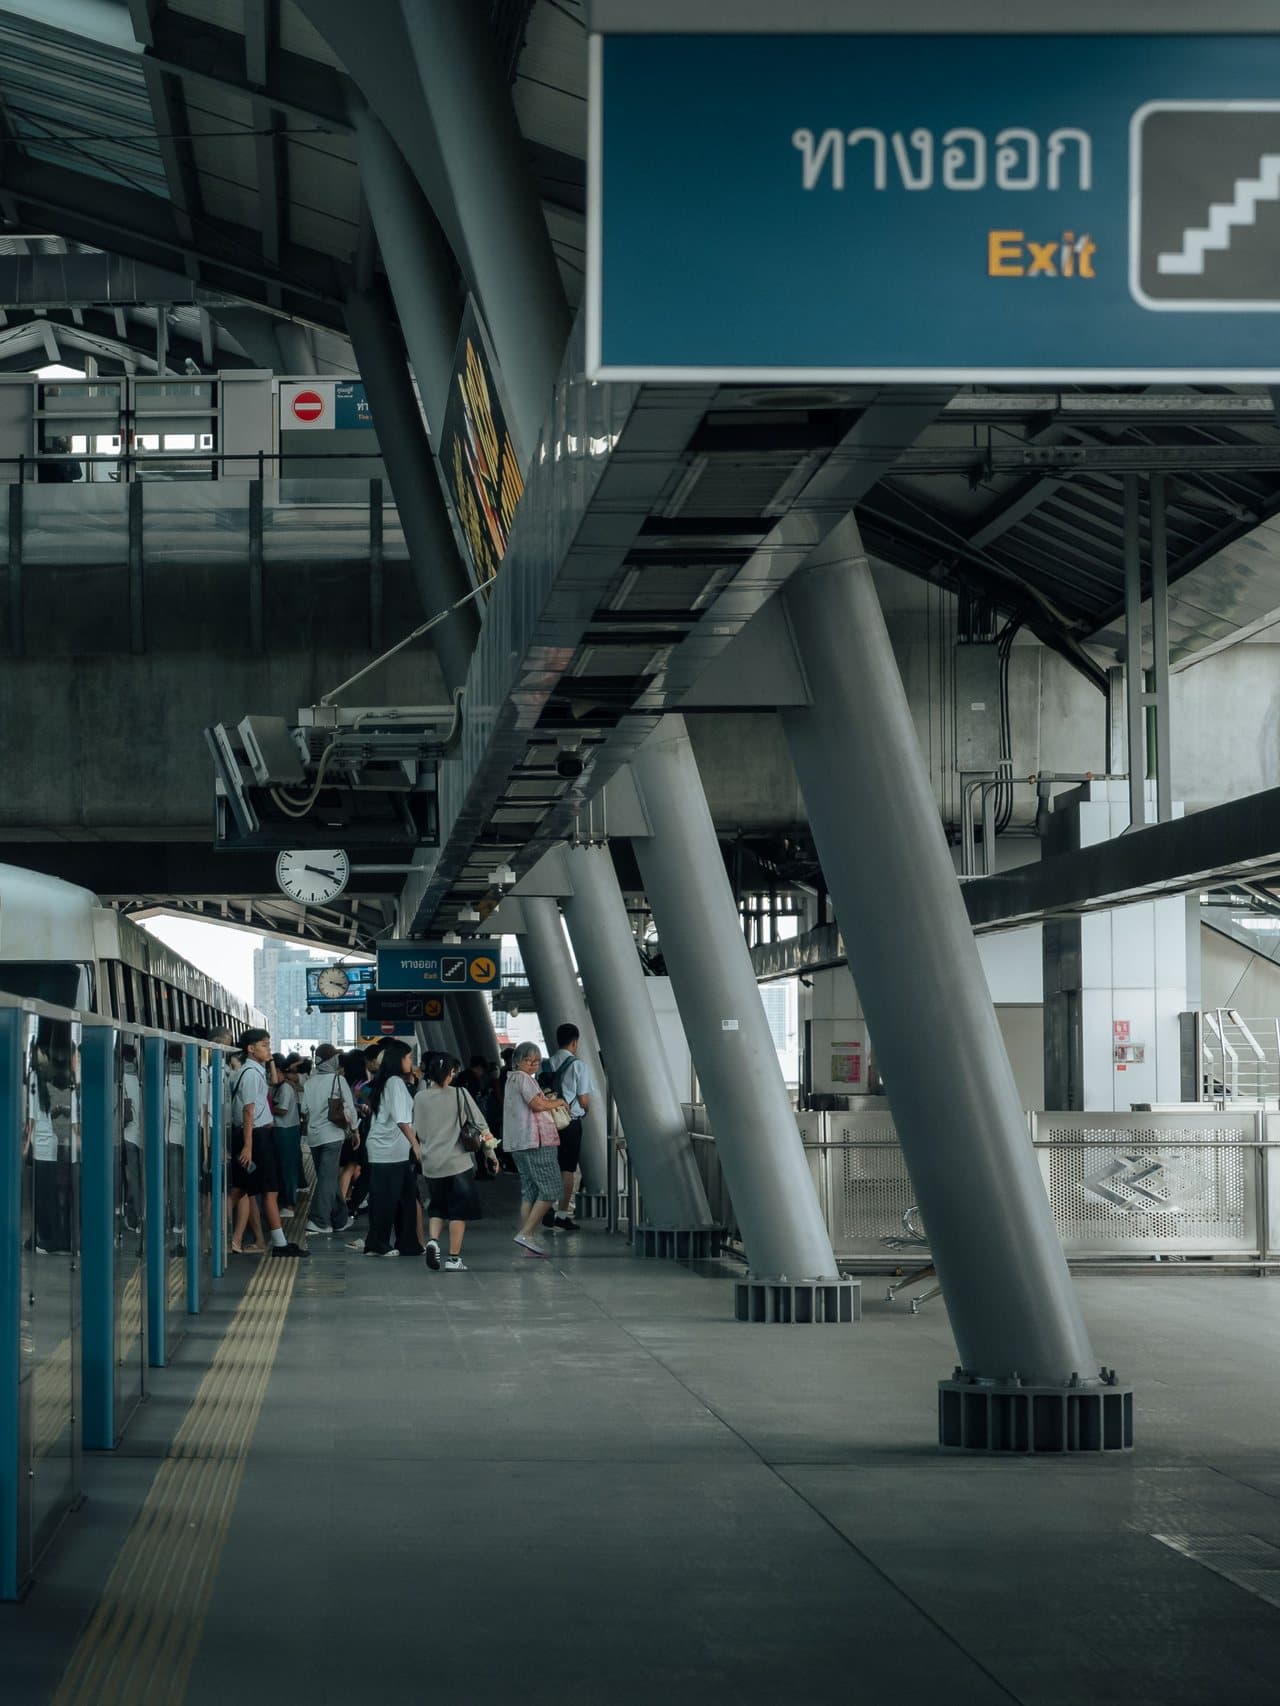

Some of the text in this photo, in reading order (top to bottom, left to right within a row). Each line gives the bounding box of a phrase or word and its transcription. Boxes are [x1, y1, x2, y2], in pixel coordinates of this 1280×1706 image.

[791, 128, 1093, 192] ทางออก
[988, 230, 1096, 278] Exit
[400, 959, 437, 969] ทางออก
